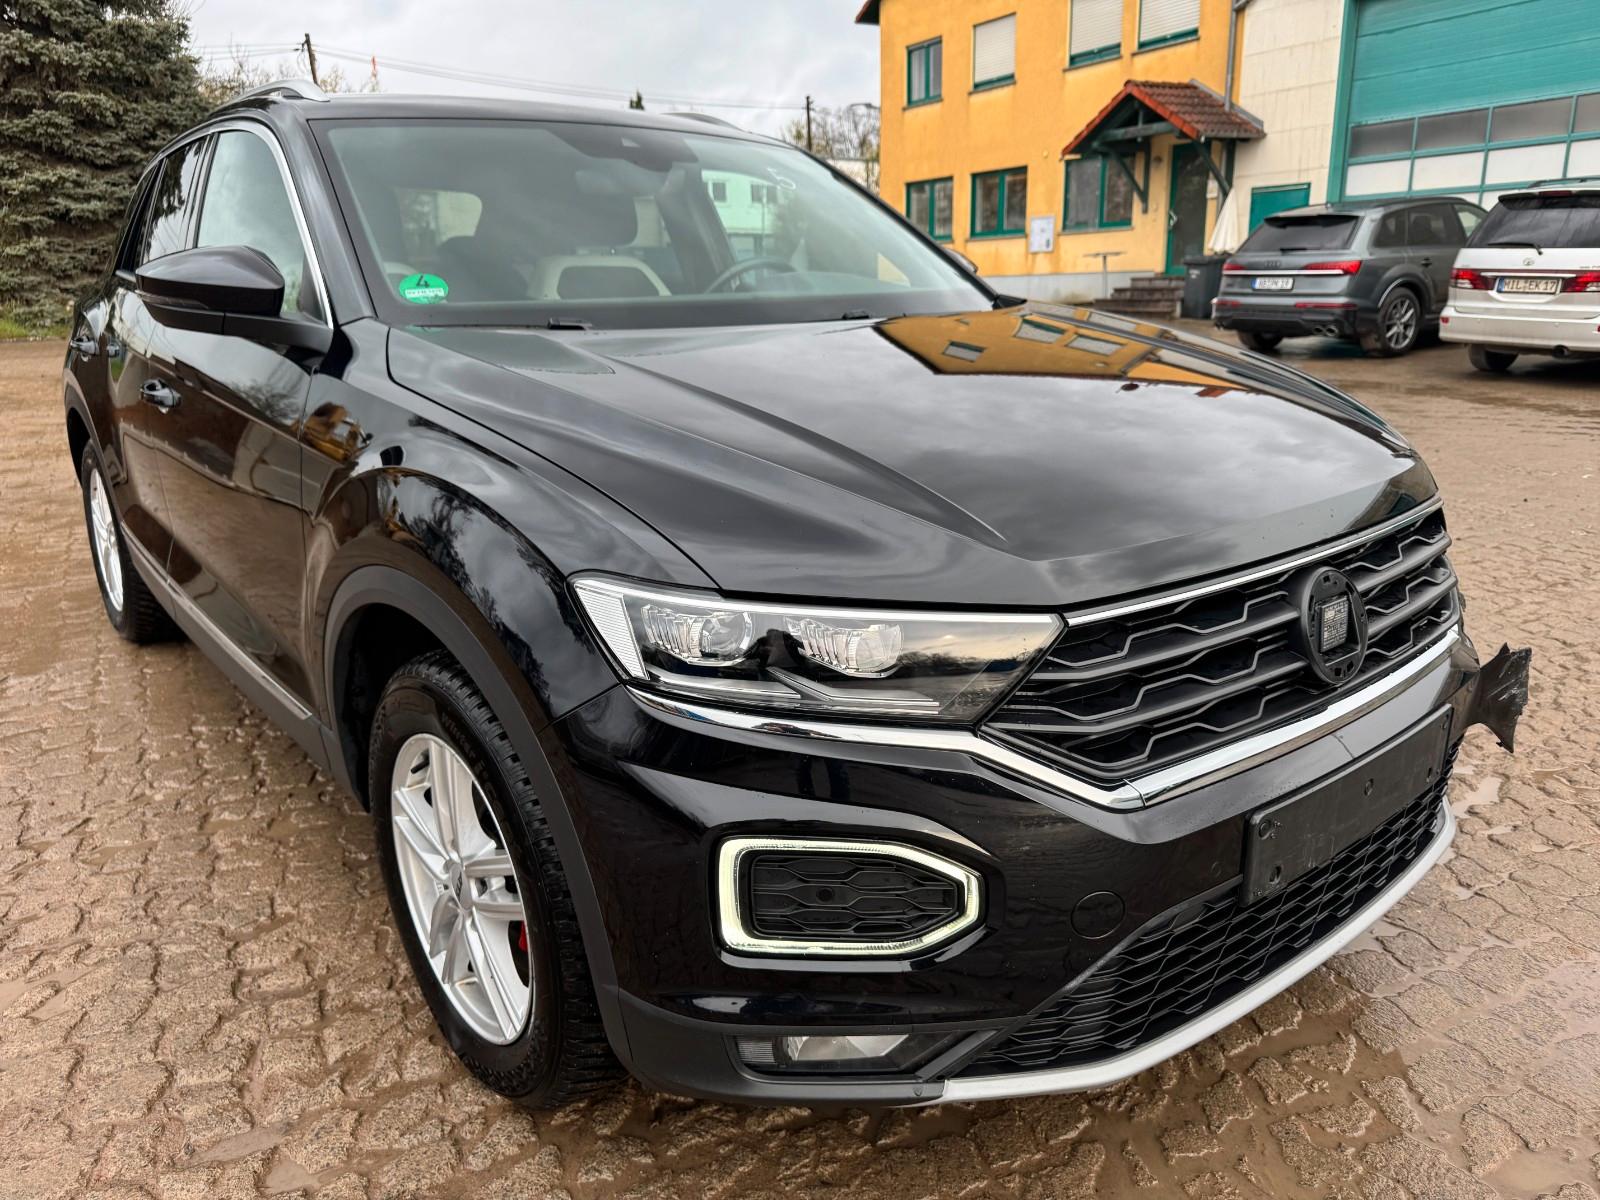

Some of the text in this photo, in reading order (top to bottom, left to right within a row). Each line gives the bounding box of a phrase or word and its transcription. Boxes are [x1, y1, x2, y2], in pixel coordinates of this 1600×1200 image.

[416, 274, 430, 288] 4
[1504, 279, 1522, 290] MIL
[1543, 281, 1557, 291] 17
